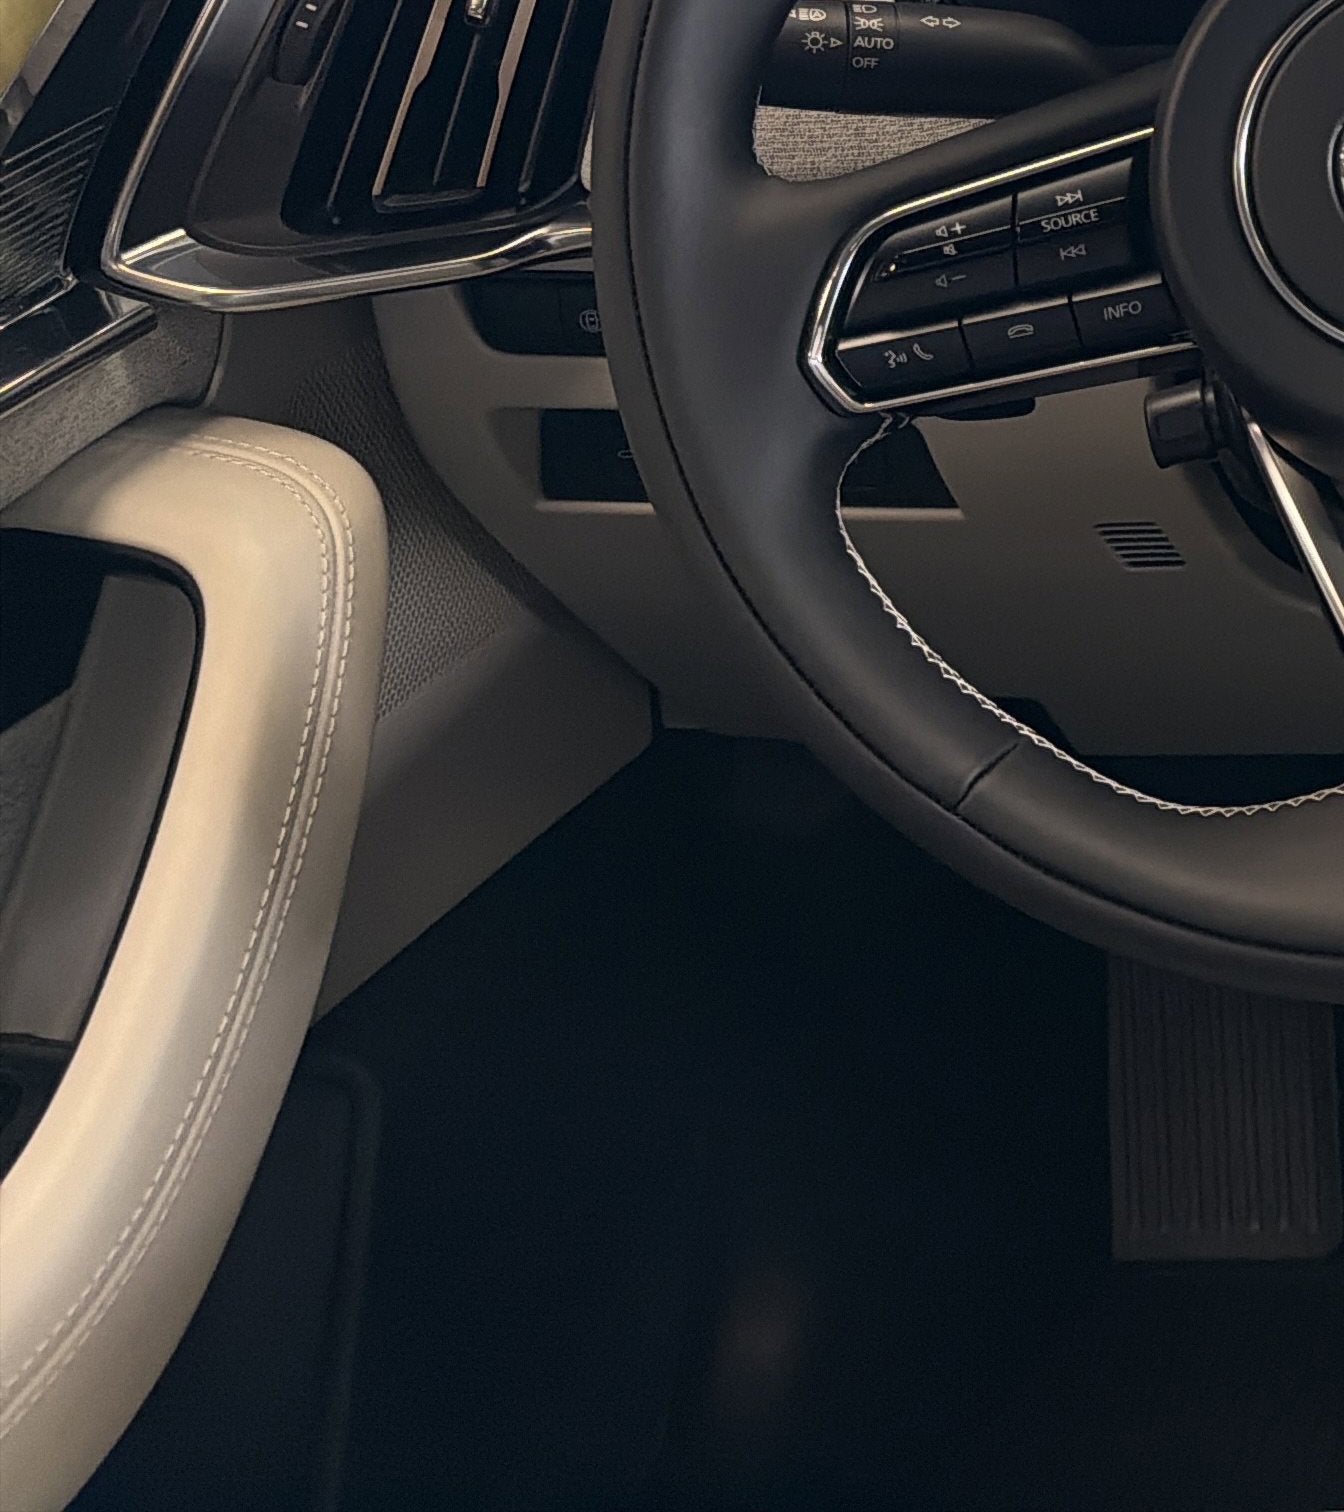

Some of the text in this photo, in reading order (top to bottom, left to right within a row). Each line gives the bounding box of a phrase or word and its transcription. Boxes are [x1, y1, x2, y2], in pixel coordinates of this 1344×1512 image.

[853, 35, 895, 51] AUTO
[852, 55, 880, 70] OFF
[1040, 208, 1100, 233] SOURCE
[1103, 299, 1143, 320] INFO
